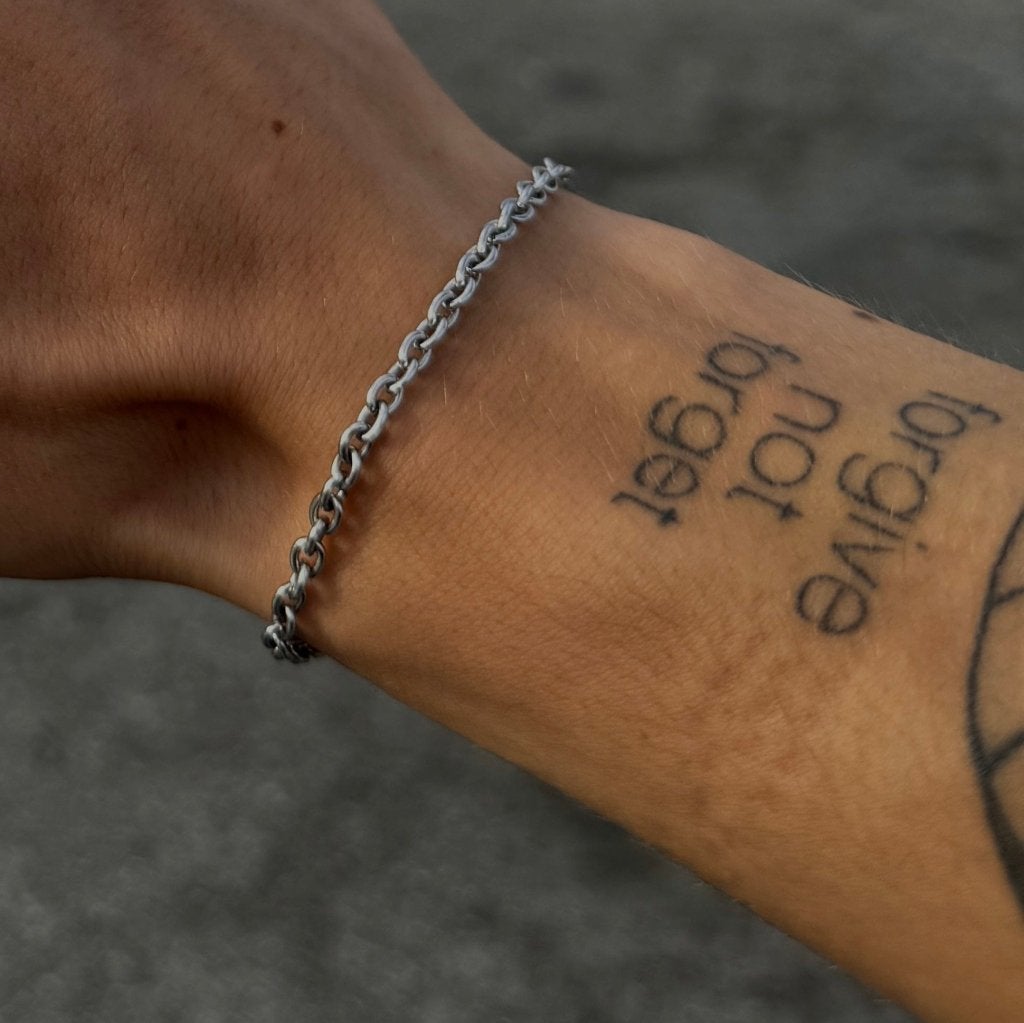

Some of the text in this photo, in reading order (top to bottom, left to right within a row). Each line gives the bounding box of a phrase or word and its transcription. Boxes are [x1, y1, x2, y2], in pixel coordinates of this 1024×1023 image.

[611, 331, 801, 527] forget
[726, 384, 842, 522] not
[795, 390, 1002, 636] forgive
